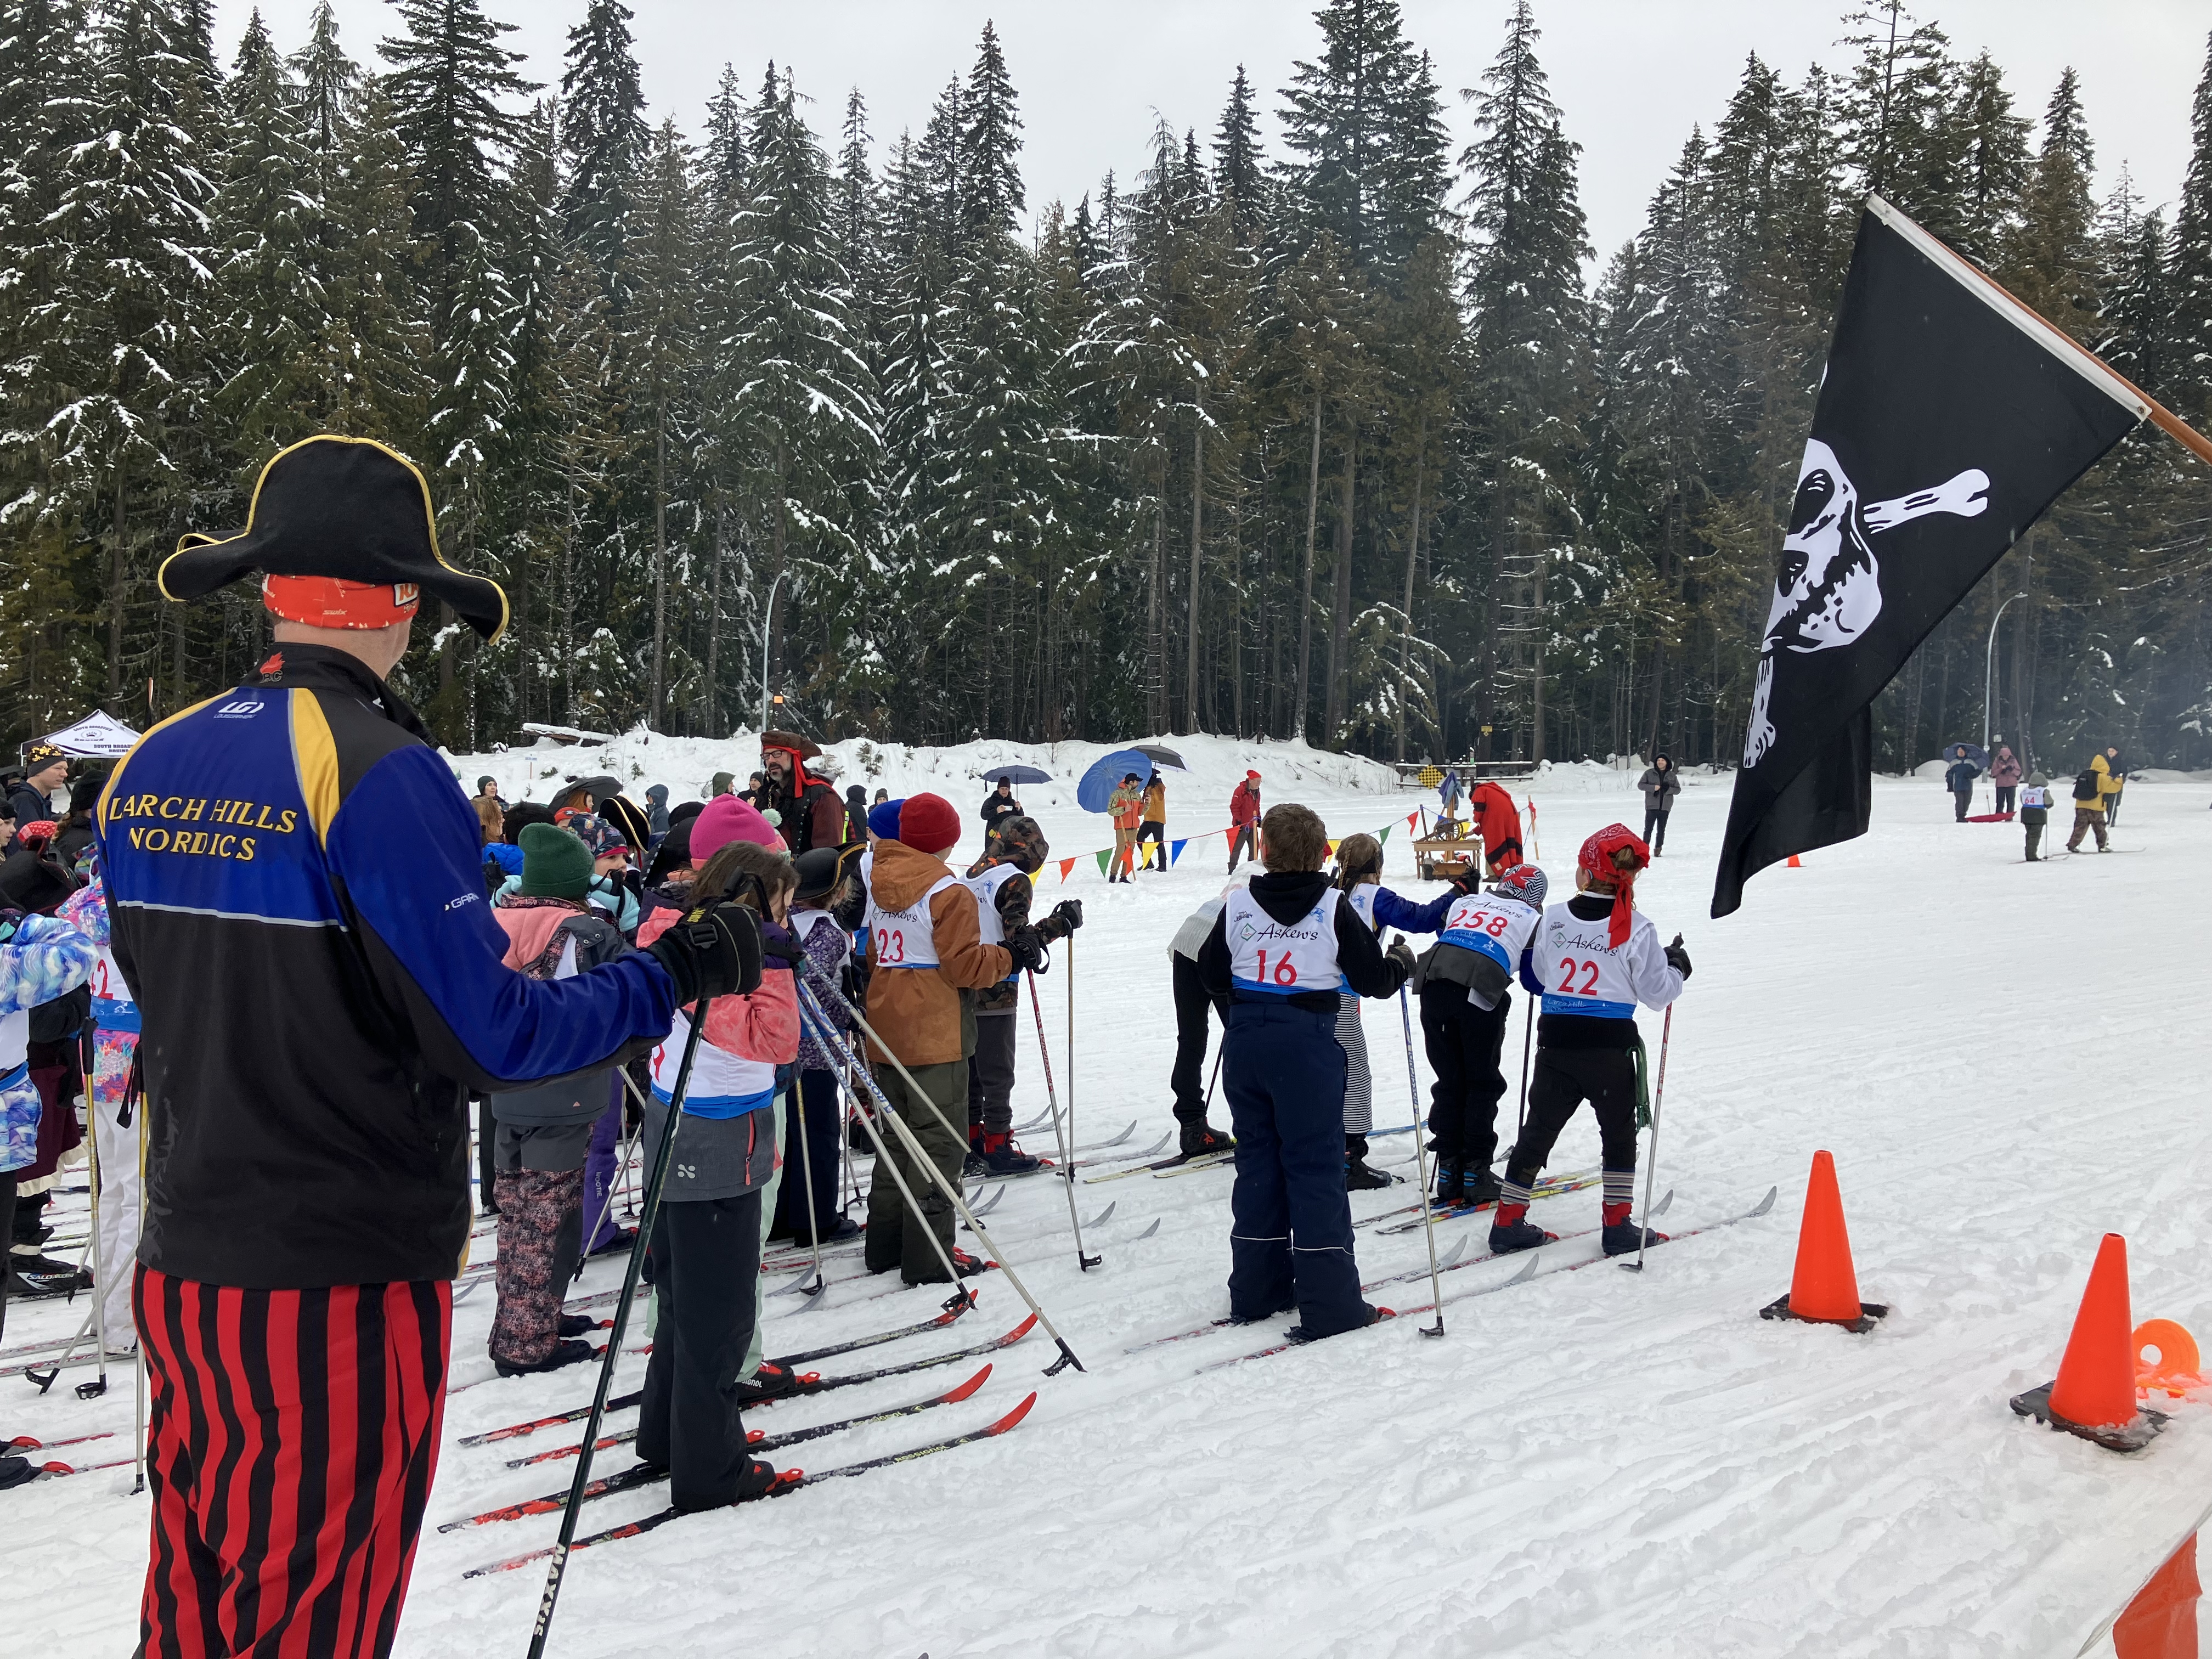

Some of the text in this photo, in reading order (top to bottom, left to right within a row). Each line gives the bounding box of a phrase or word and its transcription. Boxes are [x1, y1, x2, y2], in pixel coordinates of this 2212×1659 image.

[109, 794, 298, 833] LARCH HILLS
[2024, 796, 2035, 805] 64
[127, 827, 257, 861] NORDICS
[1256, 923, 1319, 943] Askew's
[1447, 909, 1508, 937] 258
[878, 928, 904, 963] 23
[1566, 934, 1618, 957] Askews
[1257, 950, 1297, 986] 16
[1557, 957, 1599, 996] 22
[837, 1040, 888, 1103] ROSSIGNOL
[894, 1444, 950, 1463] ROSSIGNOL
[533, 1542, 567, 1637] MAXXIS
